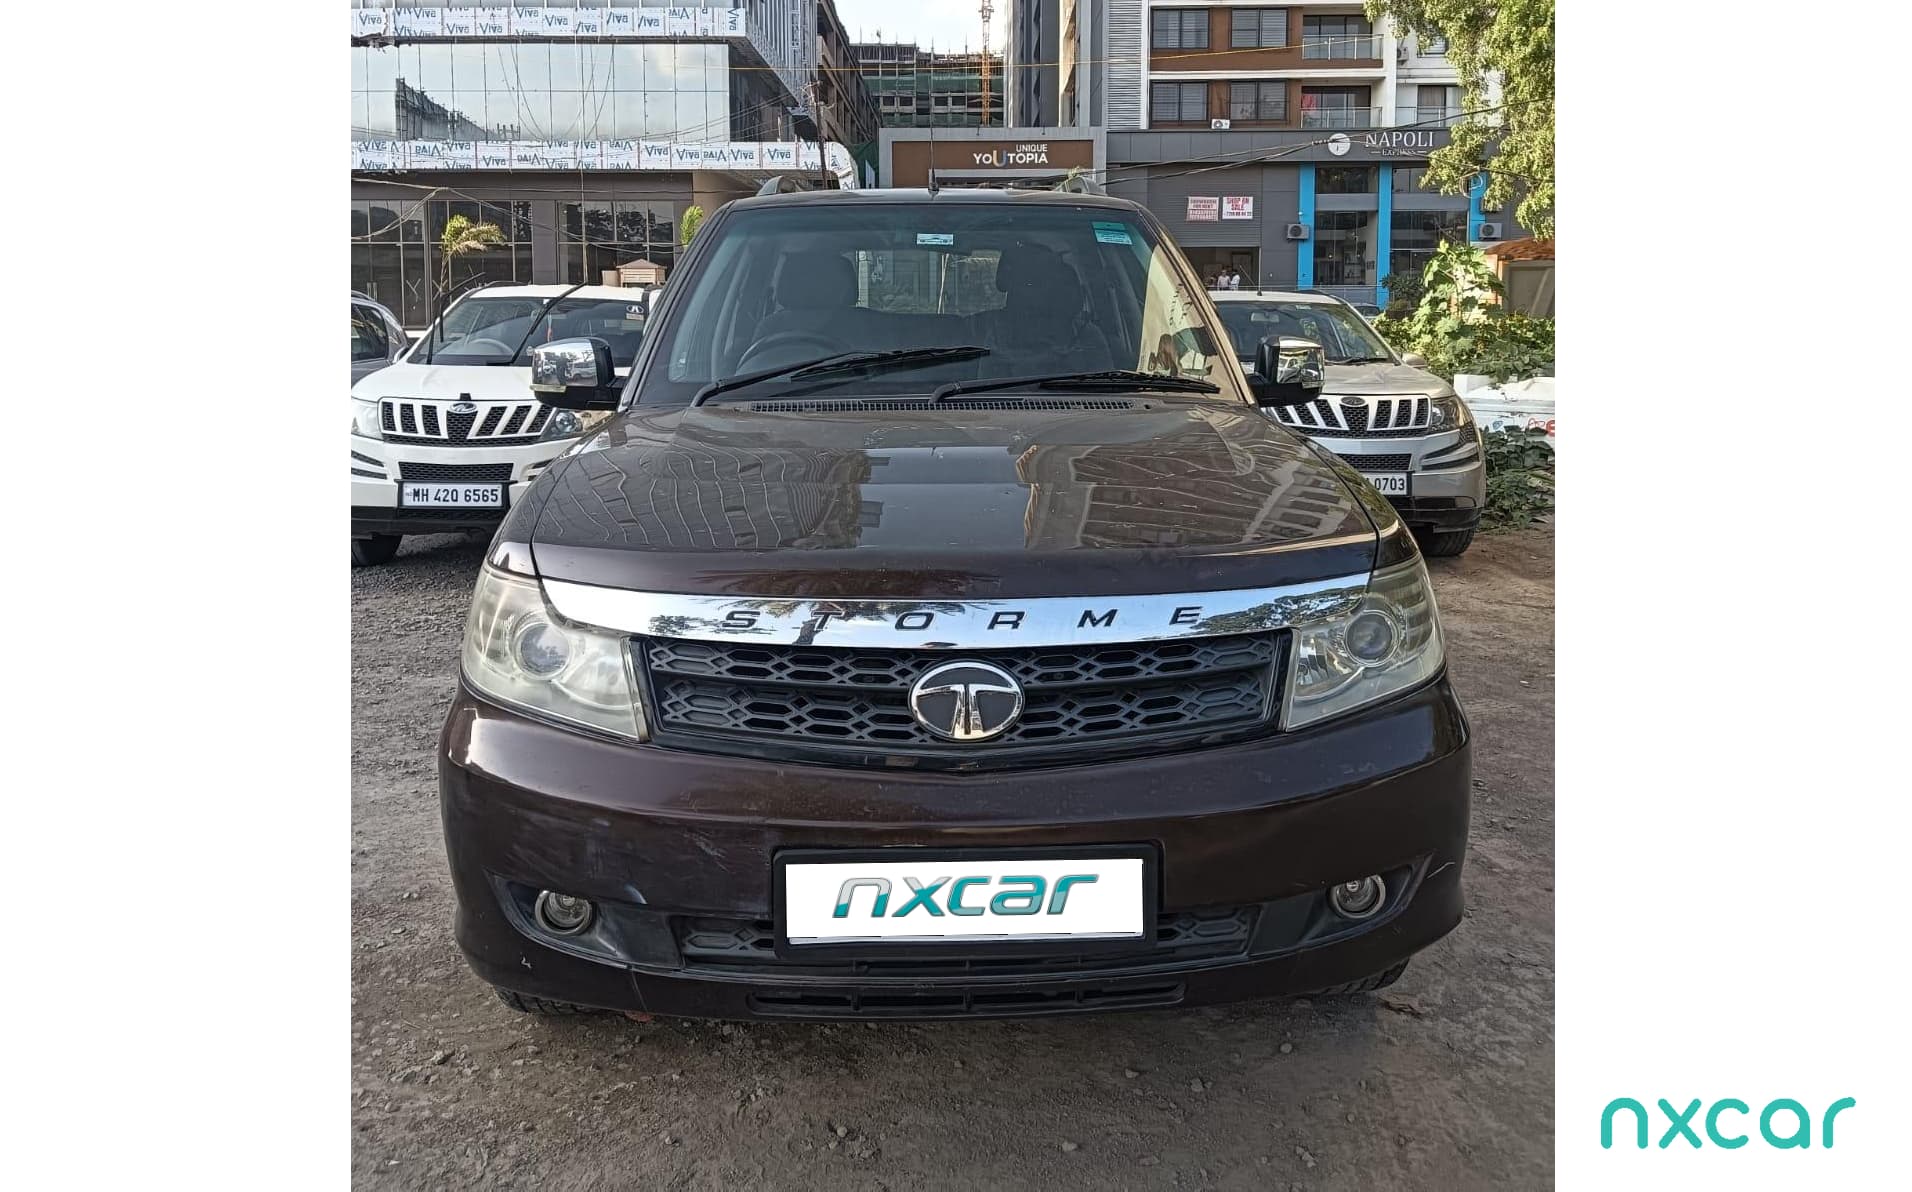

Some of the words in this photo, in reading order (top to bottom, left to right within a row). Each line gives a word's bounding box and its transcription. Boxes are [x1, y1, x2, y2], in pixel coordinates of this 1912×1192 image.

[545, 15, 568, 27] Viva
[446, 23, 469, 34] Viva
[480, 23, 503, 34] Viva
[1365, 131, 1433, 147] NAPOLI
[645, 145, 668, 157] Viva
[1015, 143, 1048, 152] UNIQUE
[676, 148, 700, 160] Viva
[731, 149, 754, 161] Viva
[767, 148, 791, 160] Viva
[483, 155, 506, 167] Viva
[1374, 477, 1405, 491] 0703
[413, 488, 429, 503] MH
[464, 488, 499, 503] 6565
[721, 605, 1204, 632] STORME
